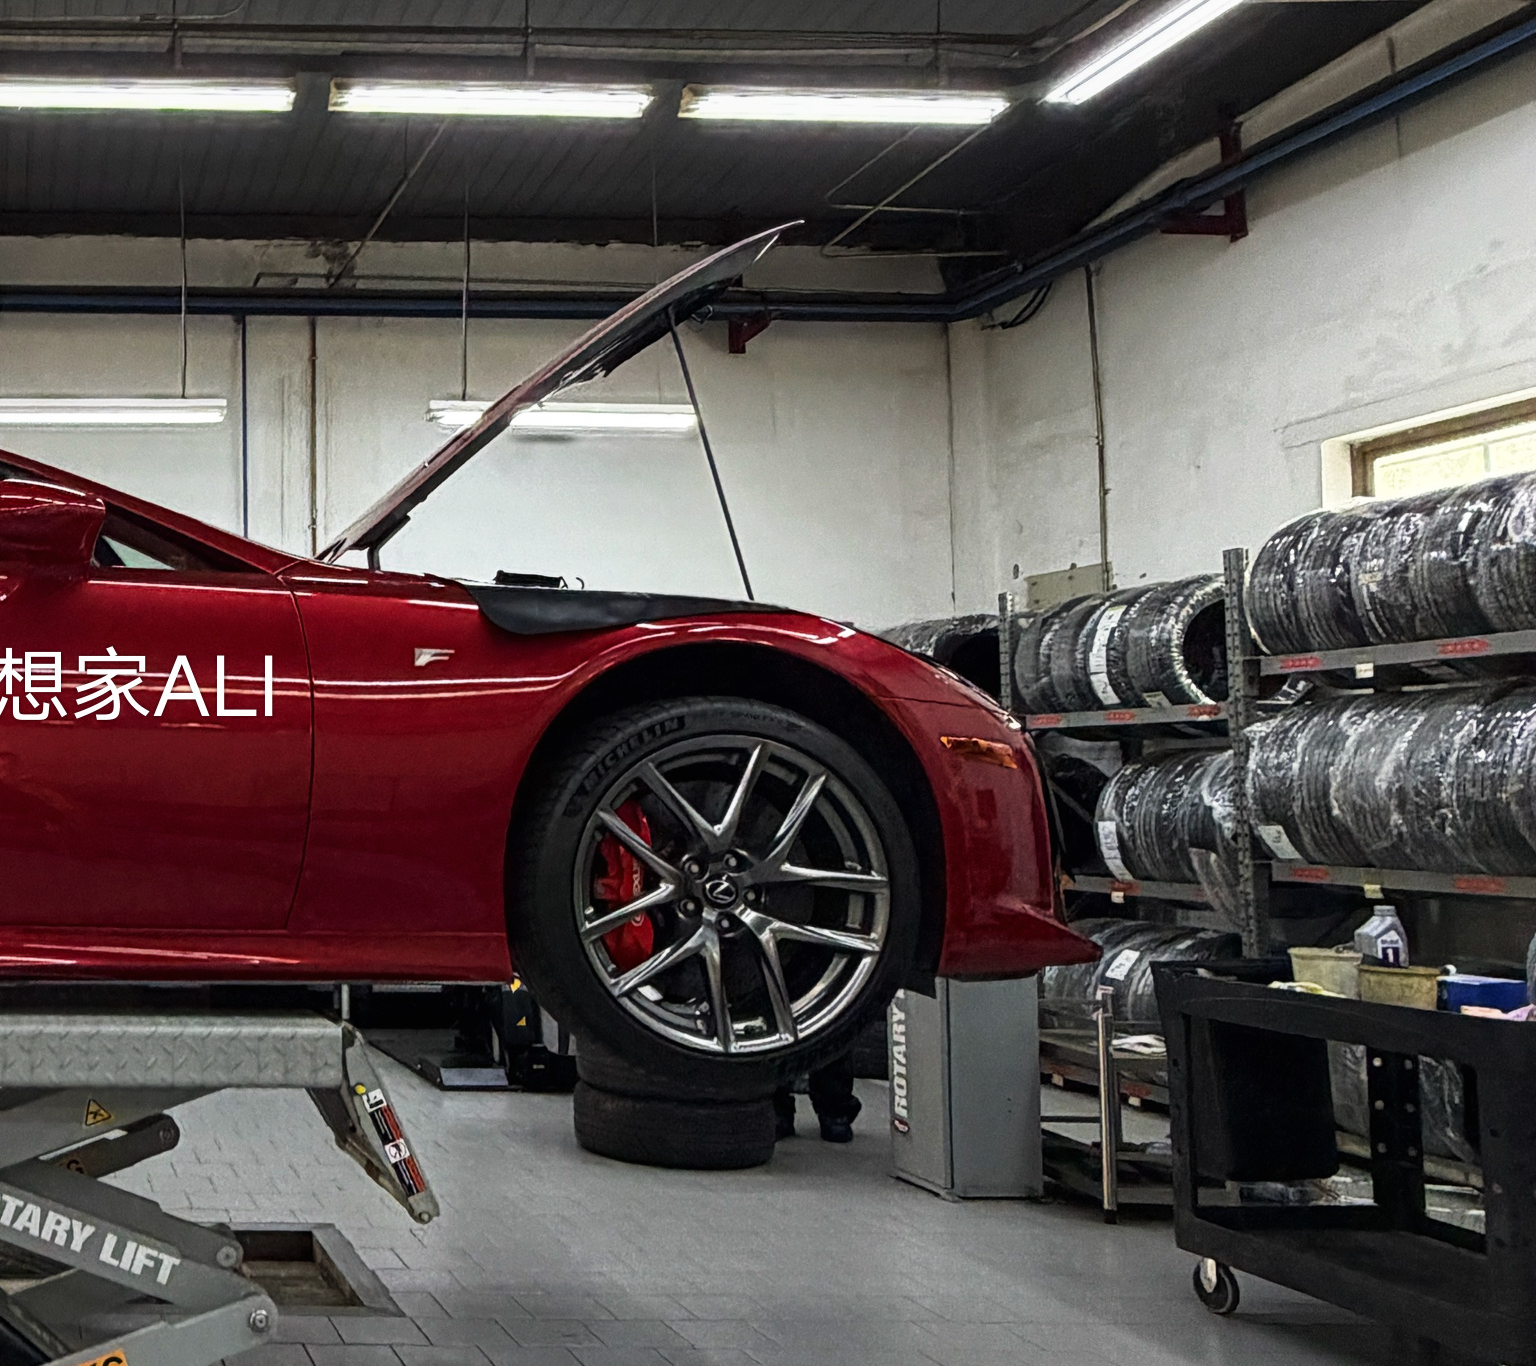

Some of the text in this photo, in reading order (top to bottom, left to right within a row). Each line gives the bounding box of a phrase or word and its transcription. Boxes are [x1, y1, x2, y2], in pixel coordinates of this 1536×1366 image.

[583, 717, 681, 792] MICHELIN
[891, 998, 908, 1119] ROTARY
[98, 1232, 182, 1285] LIFT
